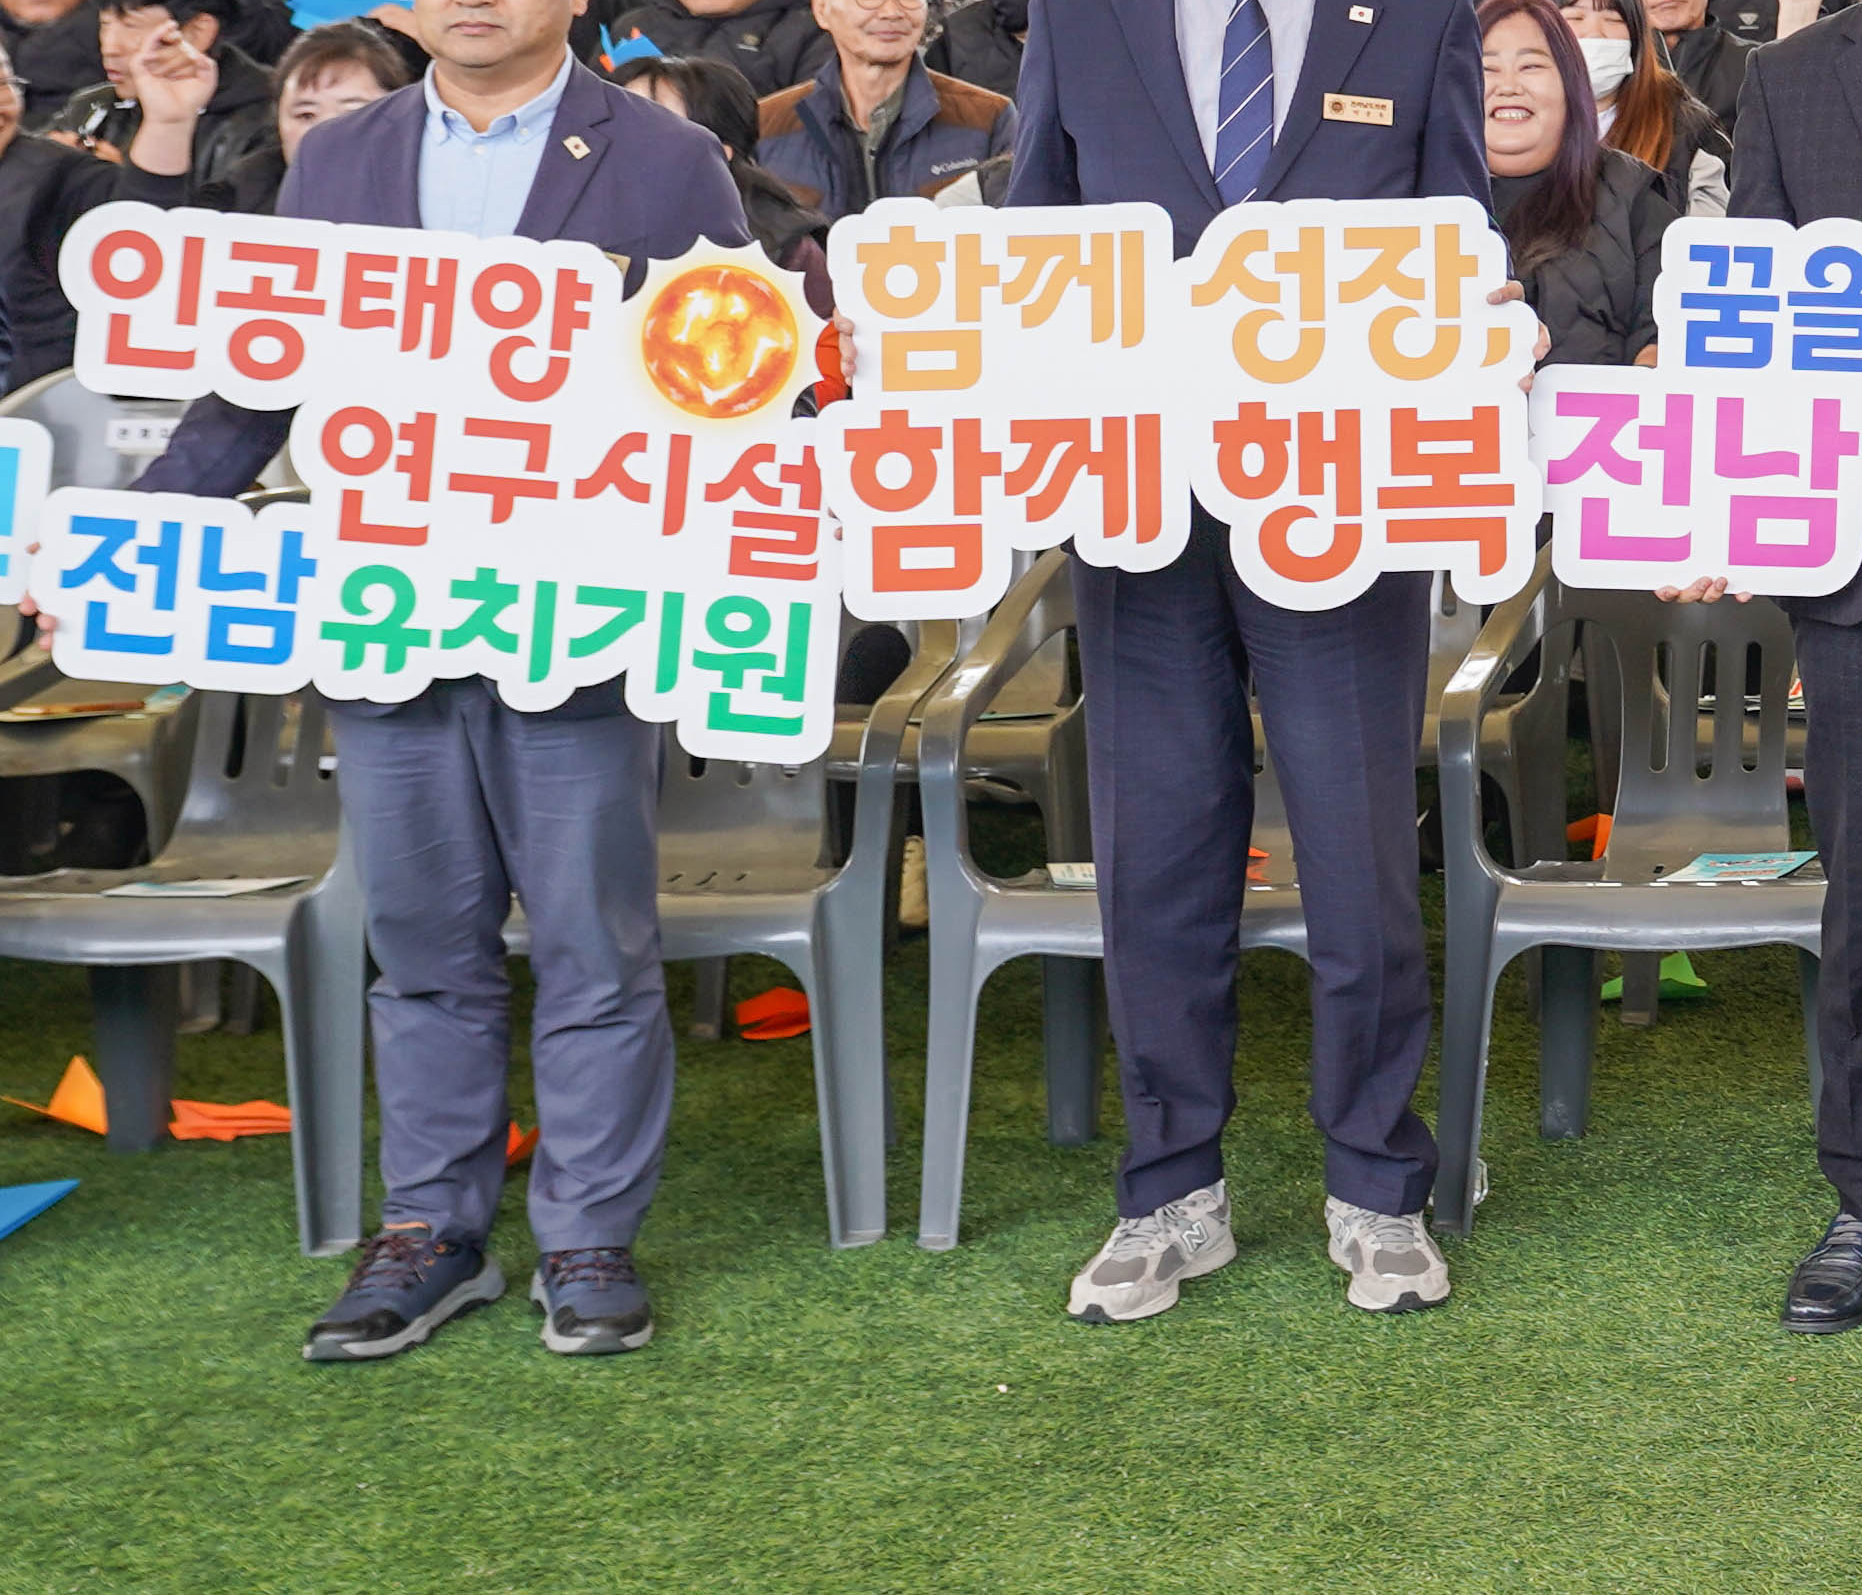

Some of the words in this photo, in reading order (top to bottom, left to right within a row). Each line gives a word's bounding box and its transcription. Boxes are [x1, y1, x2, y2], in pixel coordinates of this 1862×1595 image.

[89, 229, 595, 403] 인공태양
[856, 224, 1146, 392] 함께
[1191, 223, 1512, 385] 성장,
[319, 404, 822, 582] 연구시설
[843, 408, 1162, 593] 함께
[1212, 401, 1516, 584] 행복
[1546, 390, 1860, 569] 전남
